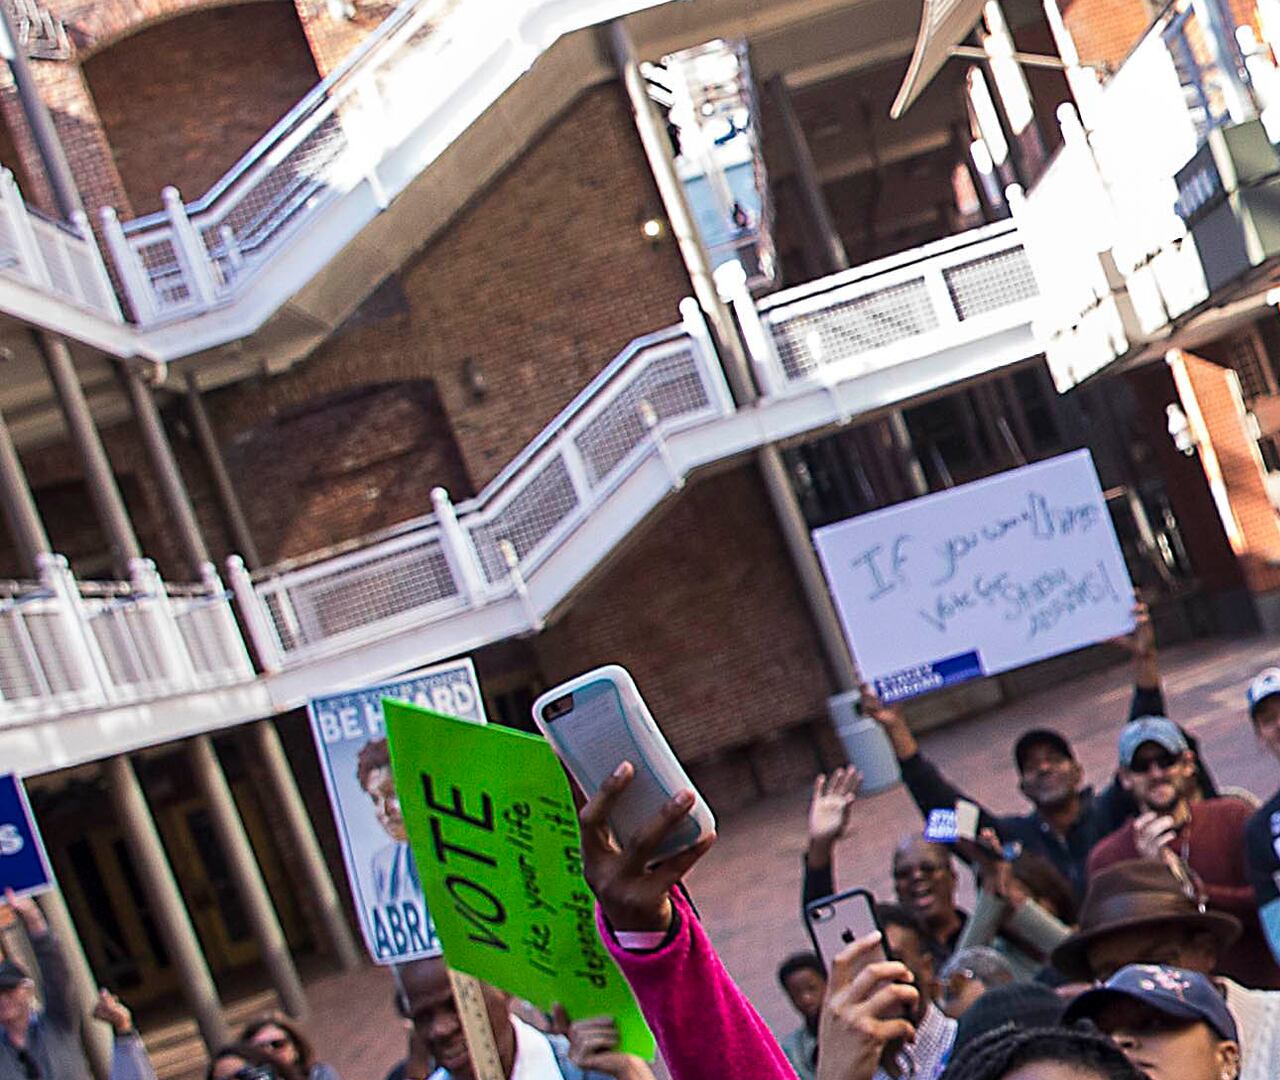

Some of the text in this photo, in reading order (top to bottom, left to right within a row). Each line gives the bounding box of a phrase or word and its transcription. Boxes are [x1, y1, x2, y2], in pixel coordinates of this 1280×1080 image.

[318, 680, 476, 743] BE HARD
[421, 772, 511, 951] VOTE
[502, 800, 559, 977] like your life
[372, 901, 441, 958] ABRA
